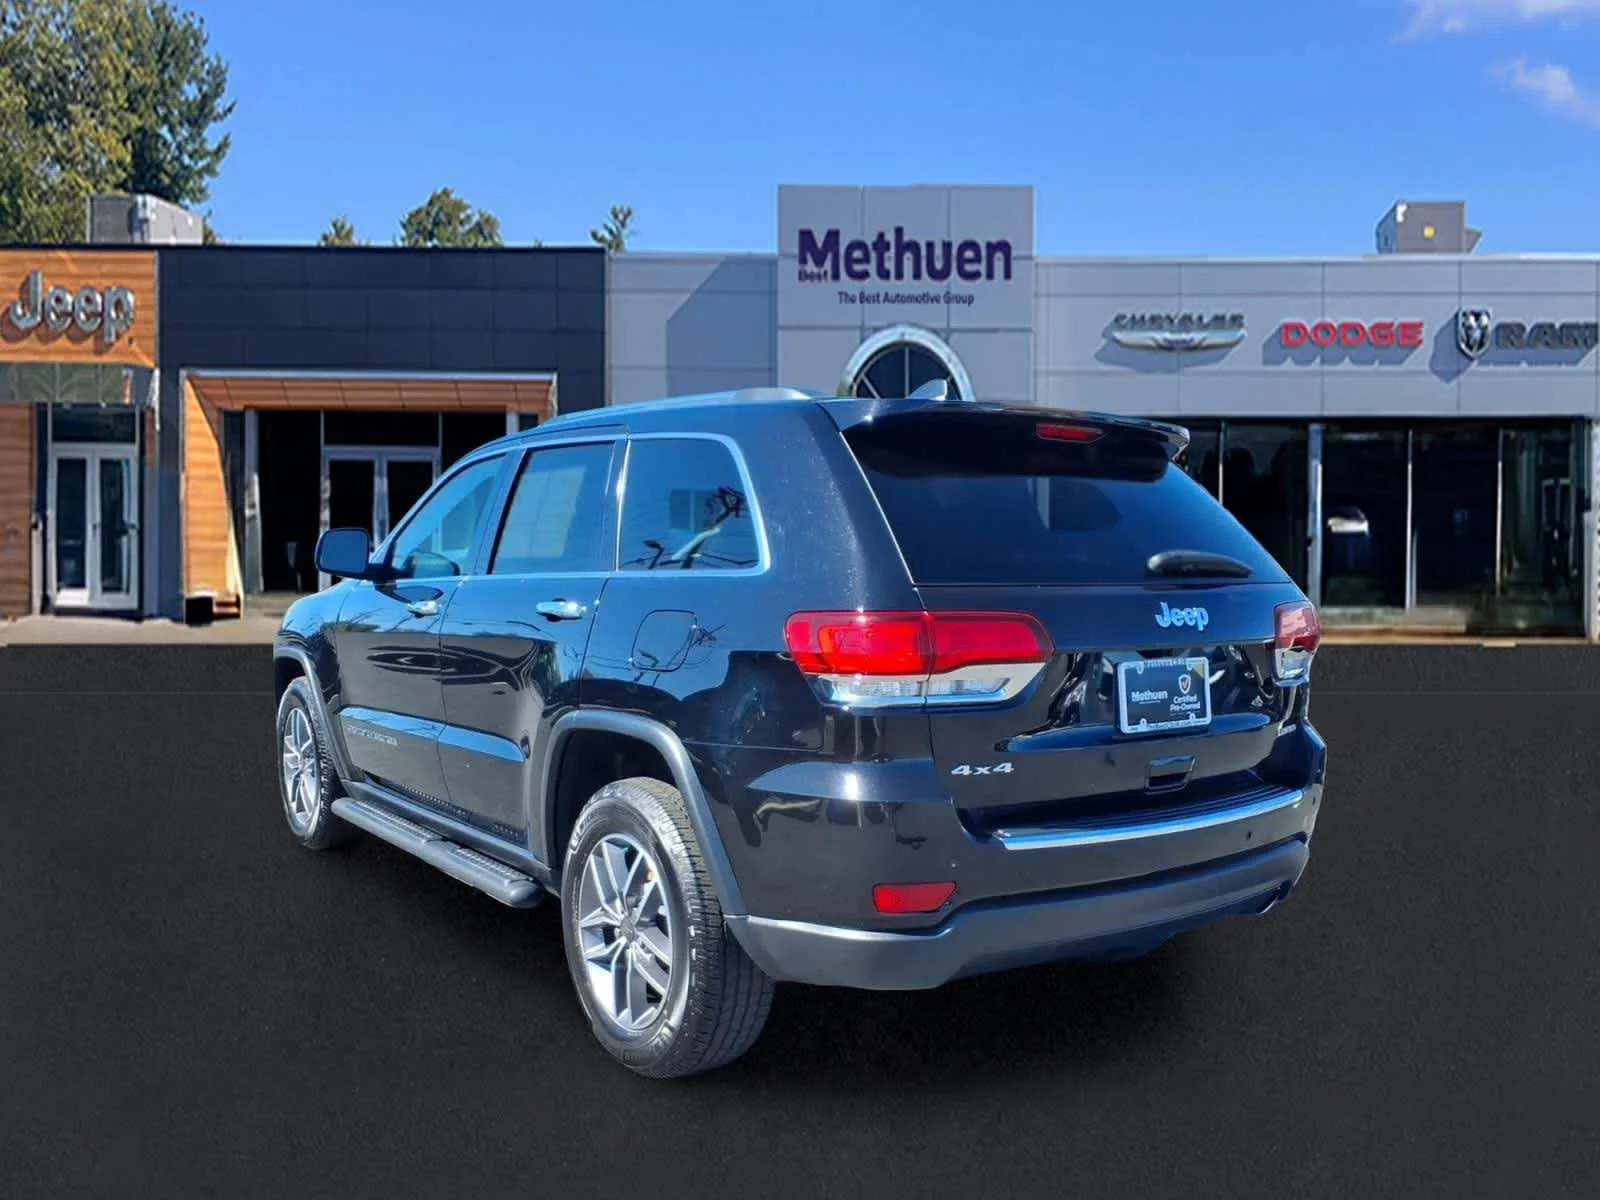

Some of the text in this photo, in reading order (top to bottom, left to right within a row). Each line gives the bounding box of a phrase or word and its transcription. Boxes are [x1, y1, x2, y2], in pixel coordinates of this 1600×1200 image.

[798, 226, 1012, 281] Methuen
[9, 271, 135, 344] Jeep
[837, 291, 974, 307] The Best Automotive Group
[1281, 321, 1424, 347] DODGE
[1495, 321, 1599, 349] RAM
[1154, 601, 1209, 631] Jeep
[1131, 690, 1168, 702] Methuen
[951, 762, 1014, 776] 4x4
